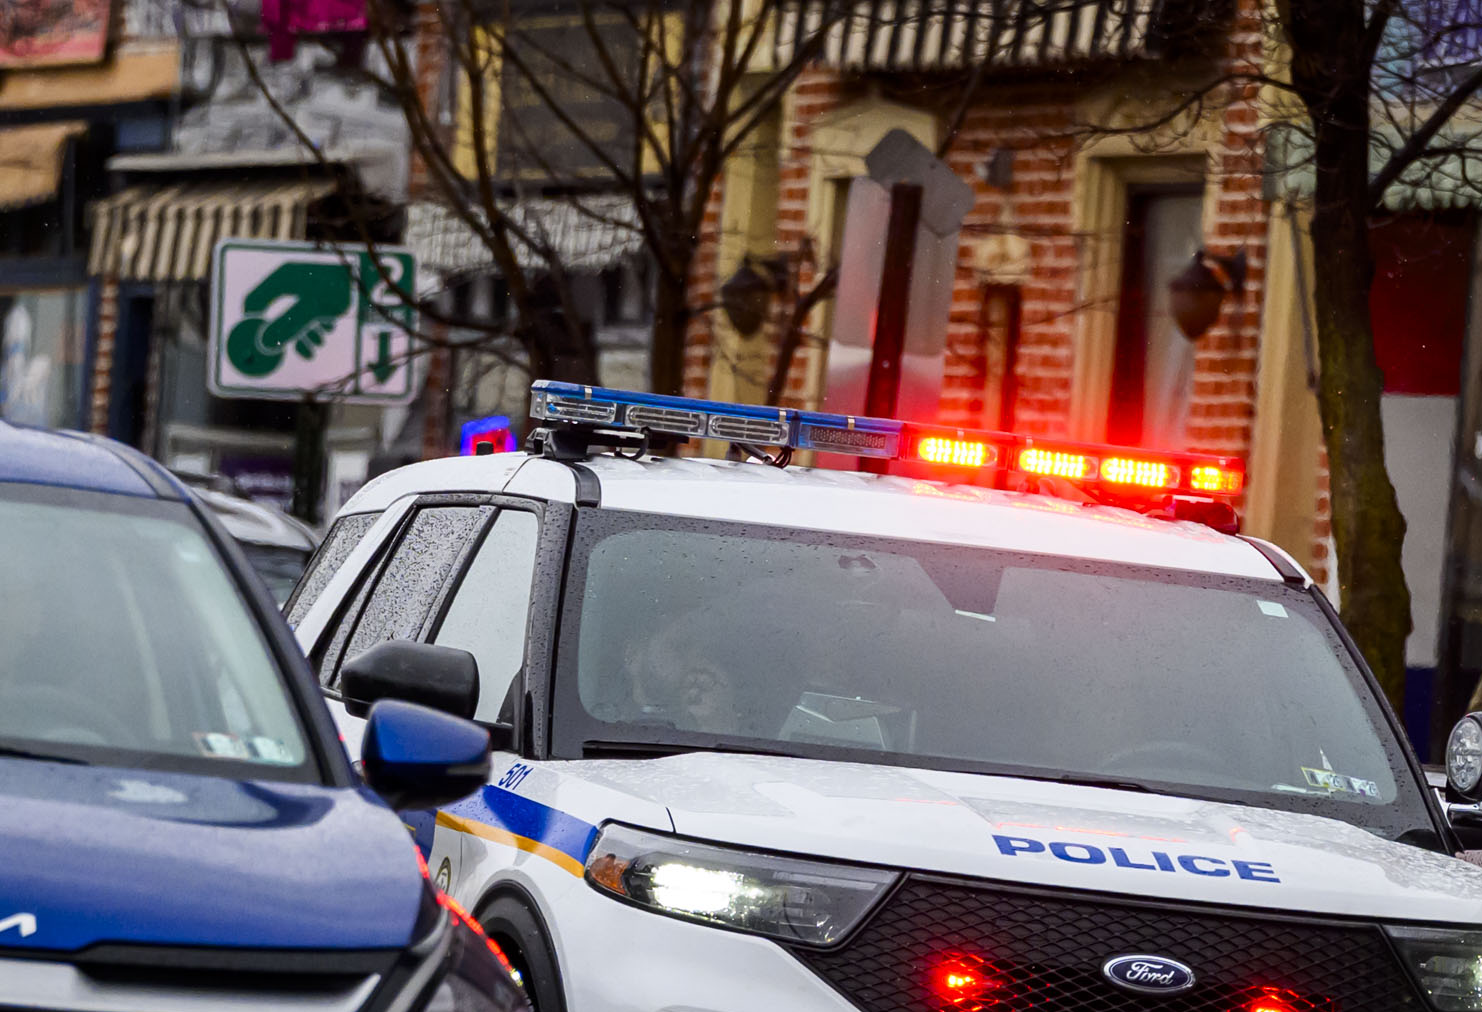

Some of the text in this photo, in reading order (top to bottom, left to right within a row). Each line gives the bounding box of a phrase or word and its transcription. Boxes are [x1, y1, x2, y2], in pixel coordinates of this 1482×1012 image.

[499, 763, 534, 791] 501
[992, 834, 1281, 883] POLICE
[1126, 960, 1175, 985] Ford
